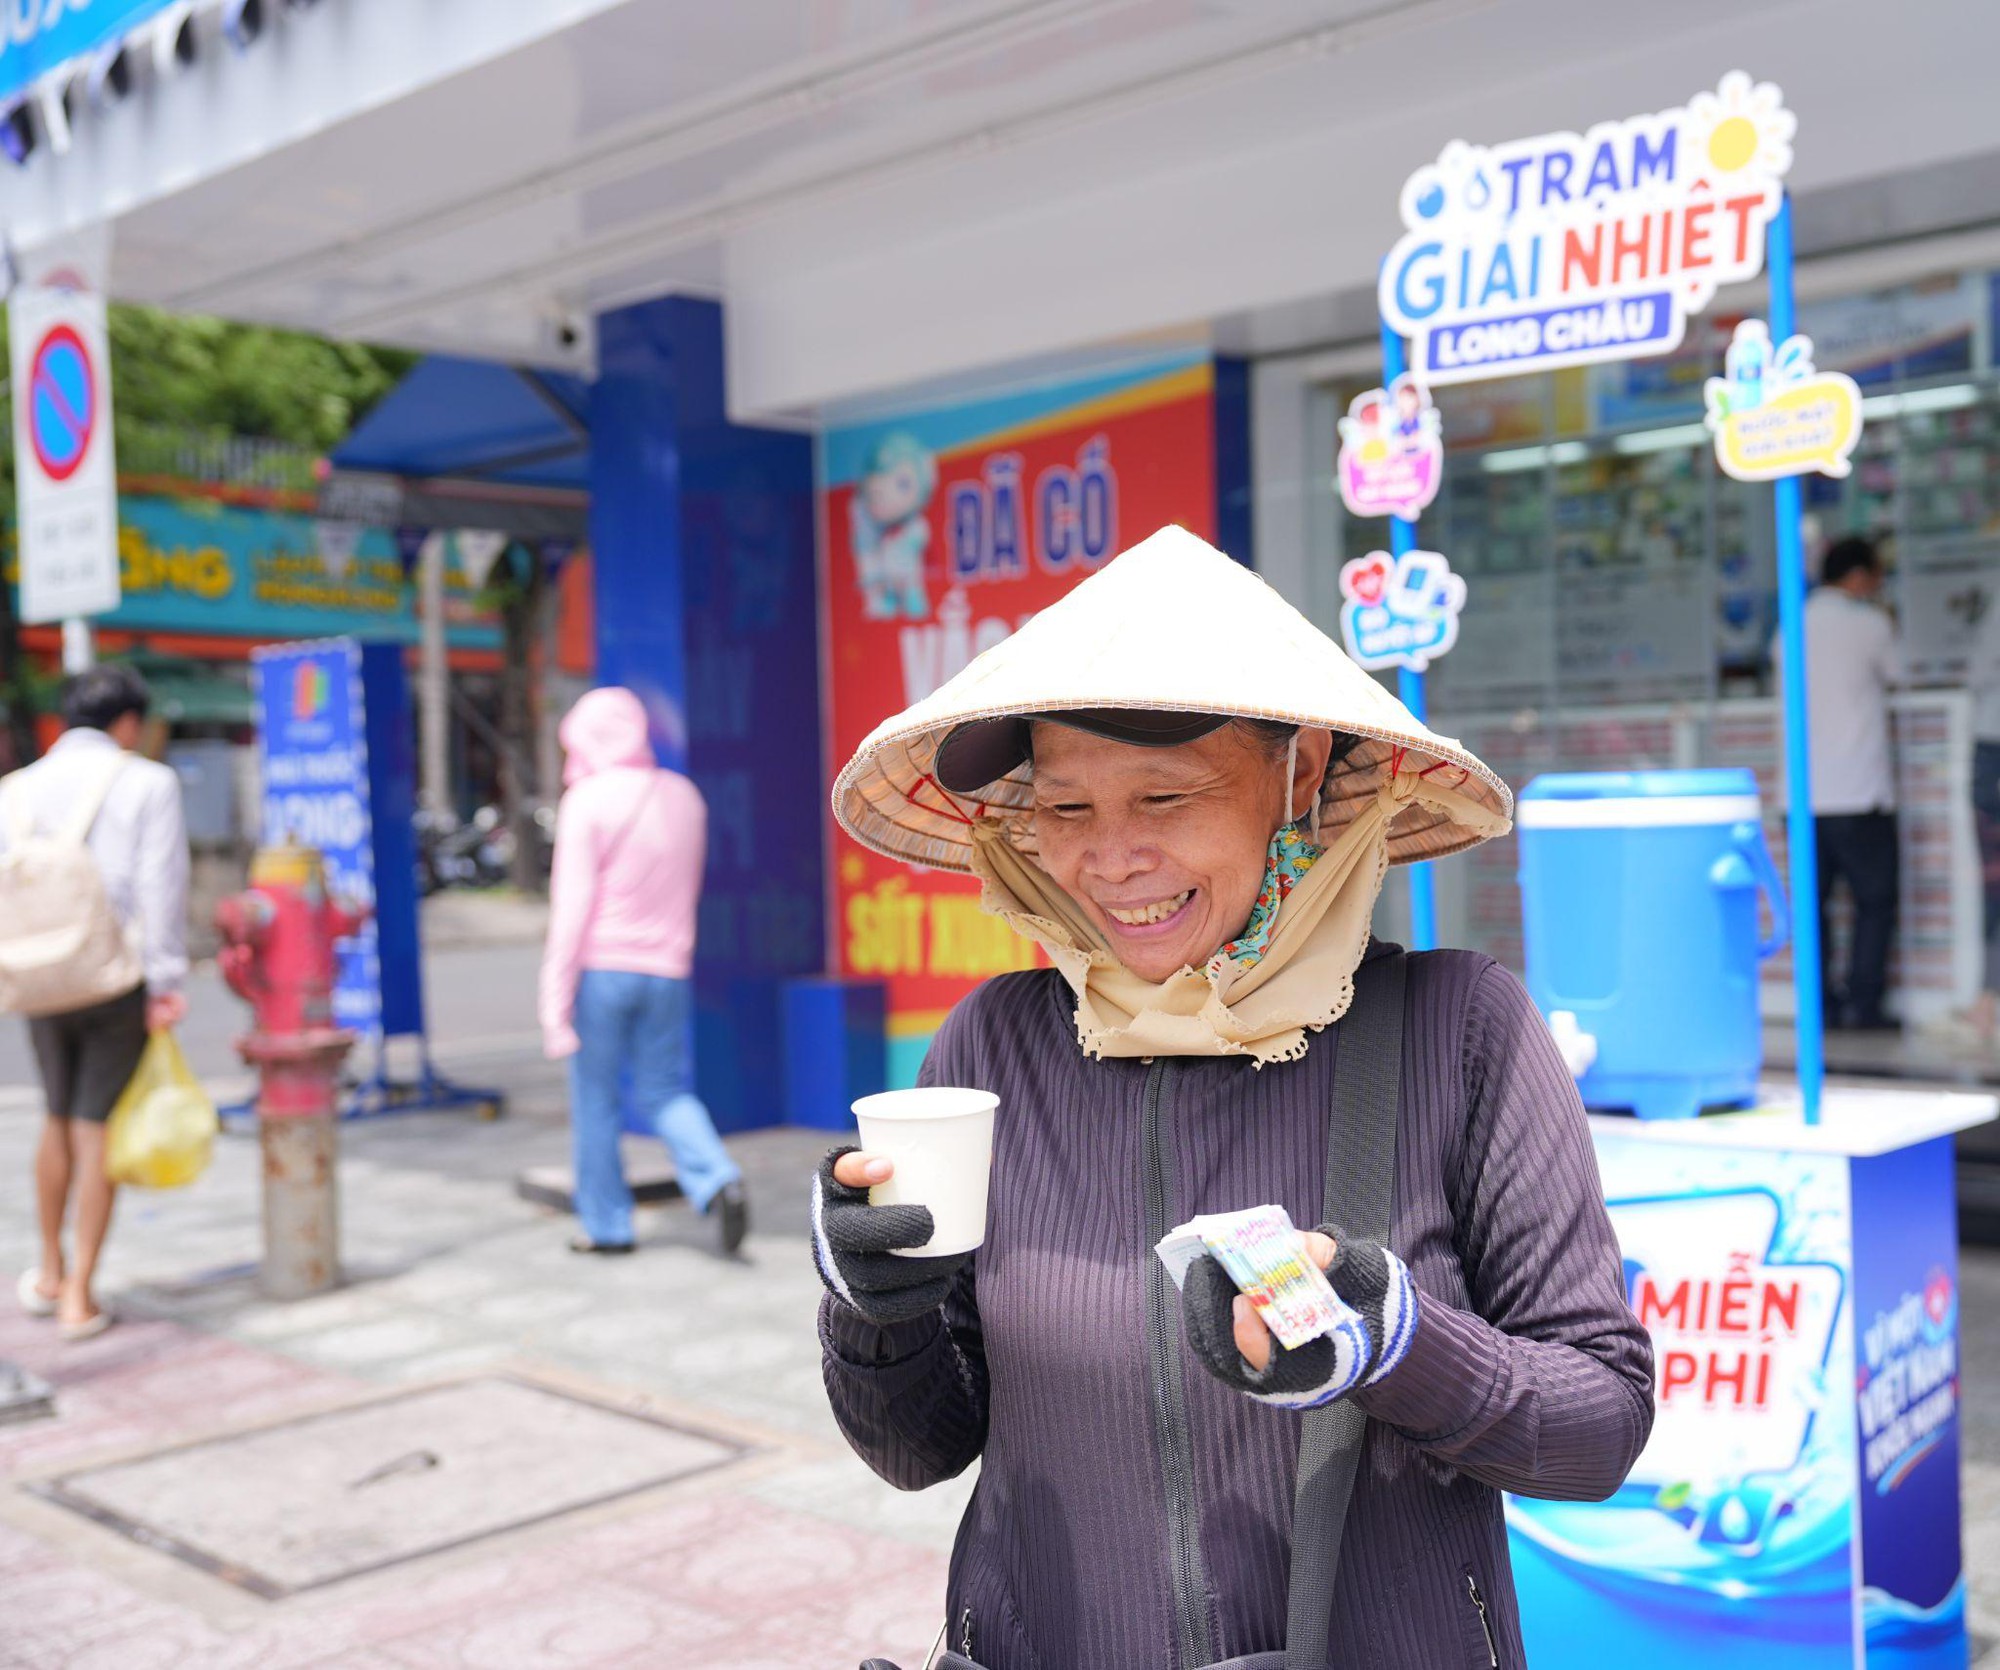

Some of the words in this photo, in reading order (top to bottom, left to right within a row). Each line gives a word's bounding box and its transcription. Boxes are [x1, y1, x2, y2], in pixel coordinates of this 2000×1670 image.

[1501, 127, 1676, 212] TRẠM
[1396, 218, 1541, 320] GIẢI
[1561, 179, 1765, 293] NHIỆT
[1437, 315, 1542, 366] LONG
[1543, 296, 1656, 352] CHÂU
[949, 453, 1024, 578] ĐÃ
[1039, 440, 1112, 568] CÓ
[847, 874, 924, 974] SỐT
[1641, 1252, 1799, 1330] MIỄN
[1661, 1335, 1770, 1405] PHÍ
